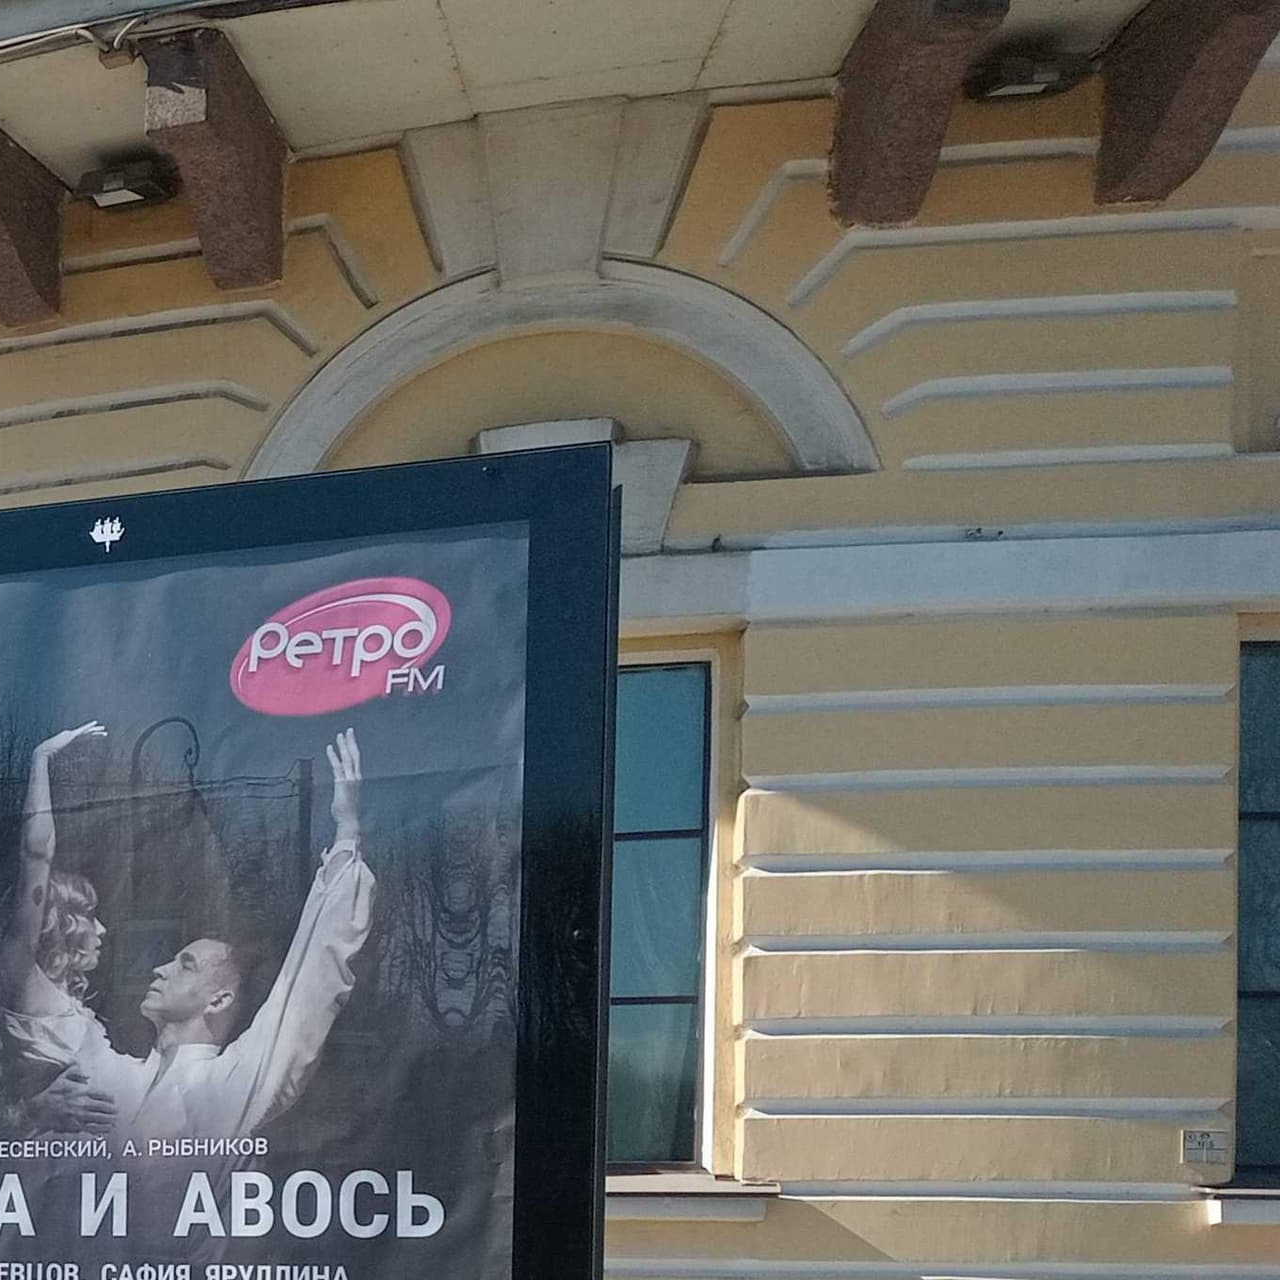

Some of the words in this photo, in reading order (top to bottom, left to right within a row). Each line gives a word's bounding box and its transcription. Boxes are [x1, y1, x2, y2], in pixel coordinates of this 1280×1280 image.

[386, 665, 445, 693] FM
[123, 1139, 142, 1157] А.
[148, 1137, 268, 1157] РЫБНИКОВ
[80, 1172, 128, 1237] И
[173, 1170, 446, 1239] АВОСЬ
